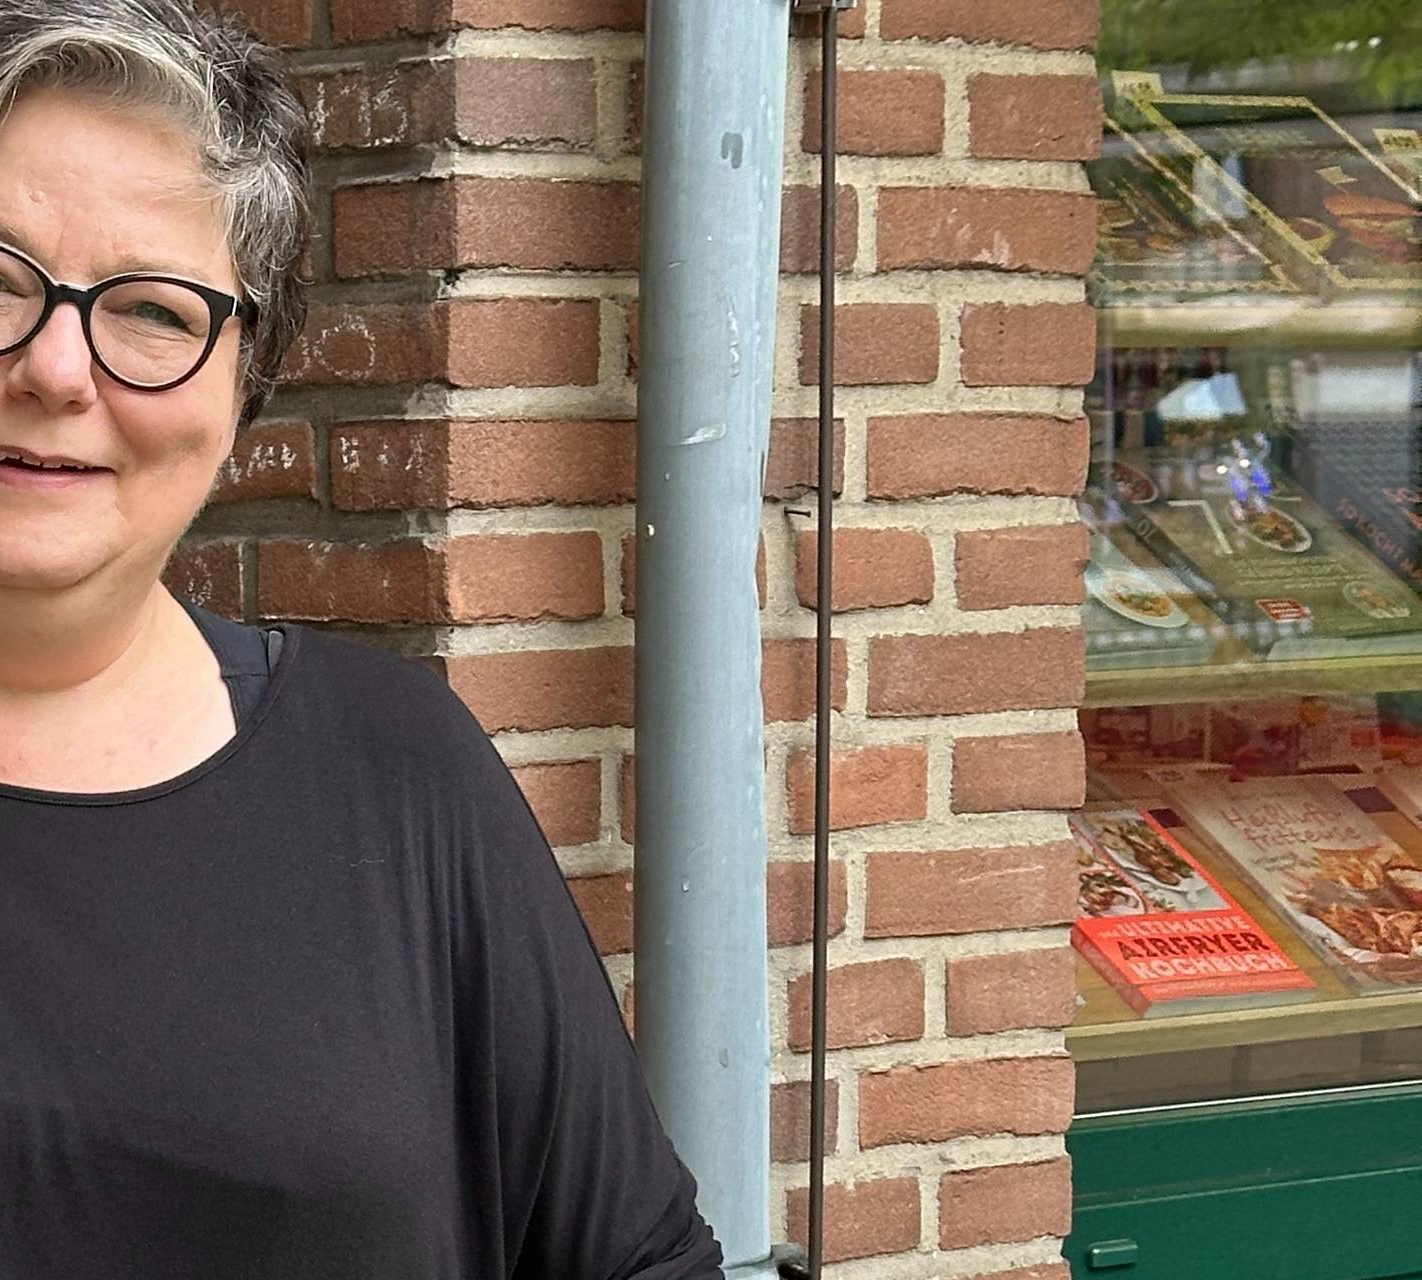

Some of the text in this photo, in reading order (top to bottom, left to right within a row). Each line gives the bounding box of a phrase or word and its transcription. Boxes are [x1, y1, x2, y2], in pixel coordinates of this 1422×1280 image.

[1116, 915, 1250, 937] ULTIMATIVE
[1117, 932, 1270, 960] AIRFRYER
[1130, 952, 1288, 980] KOCHBUCH
